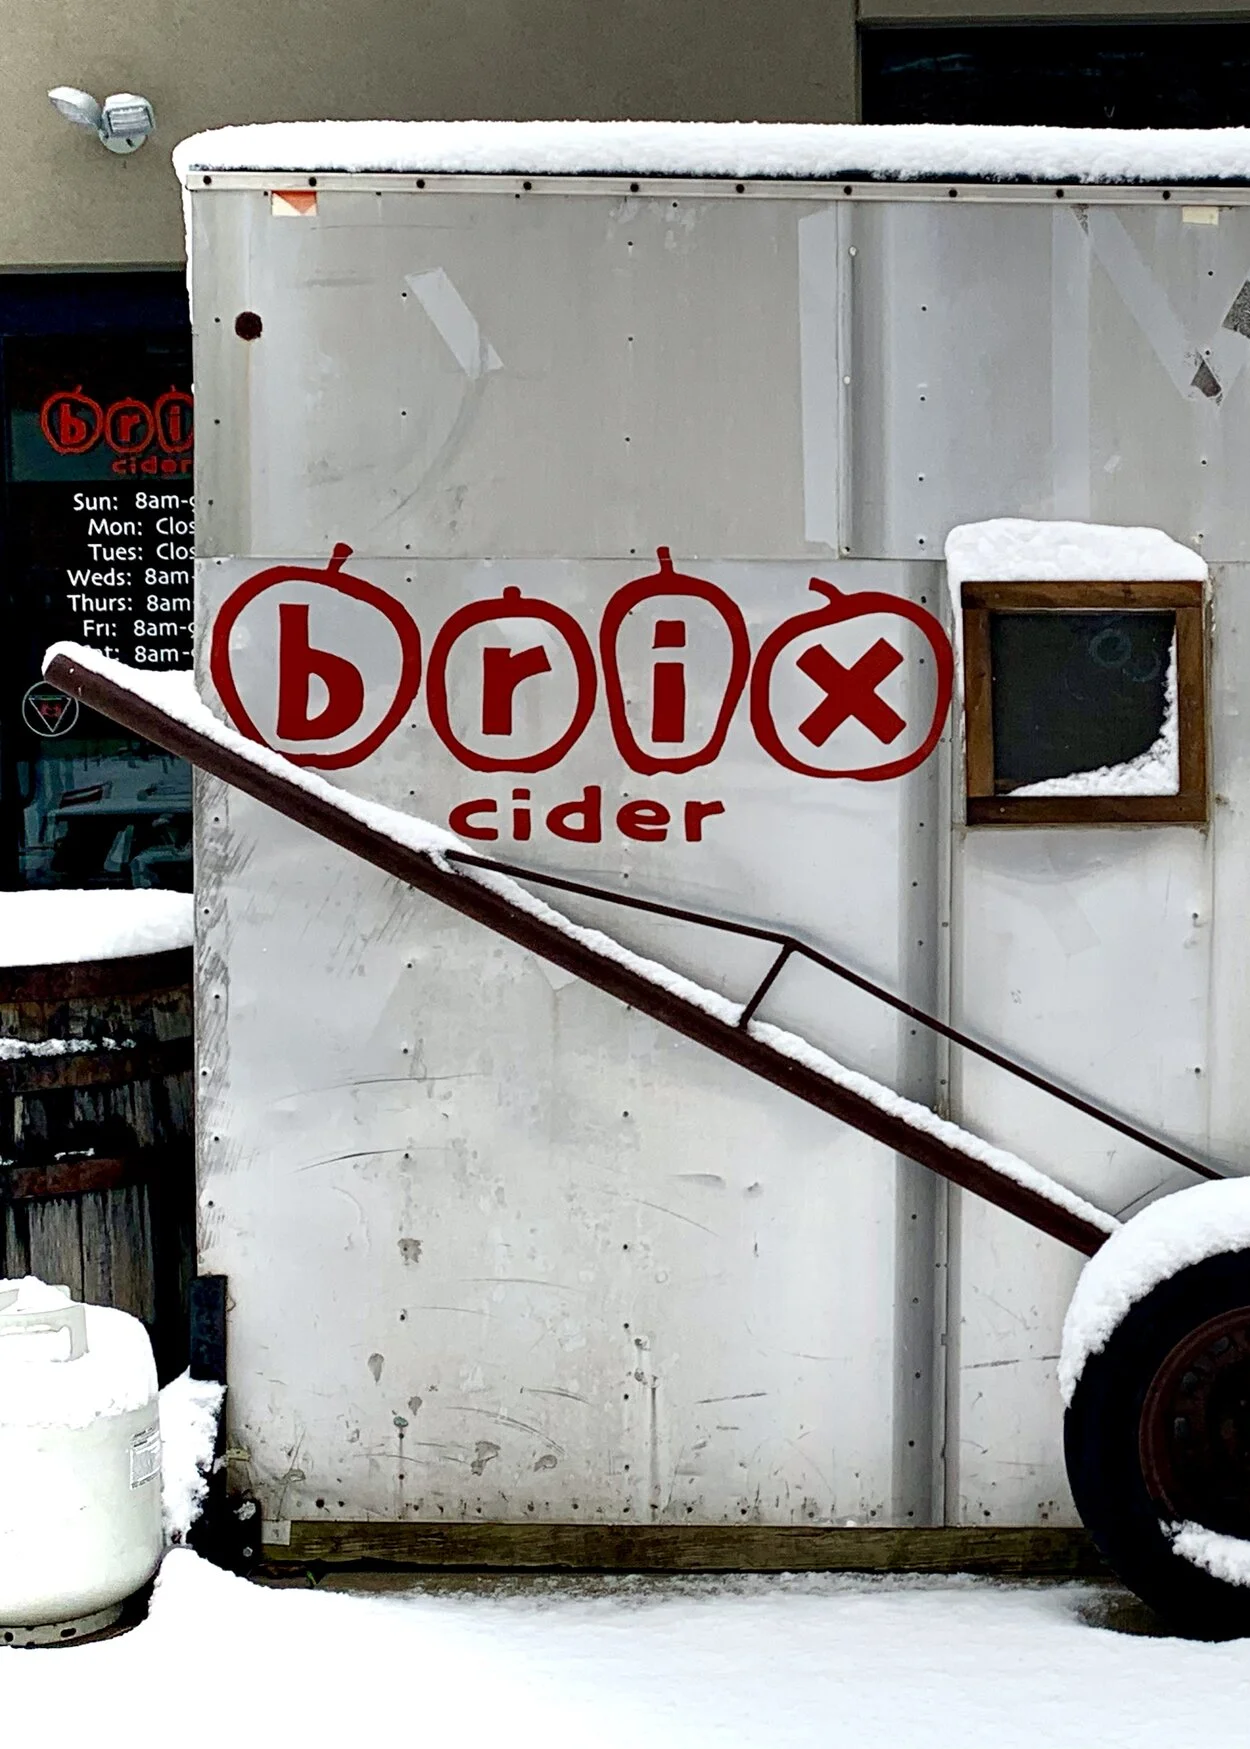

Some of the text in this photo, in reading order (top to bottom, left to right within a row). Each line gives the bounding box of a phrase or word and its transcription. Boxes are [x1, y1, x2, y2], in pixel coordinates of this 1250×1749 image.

[73, 492, 118, 511] Sun:
[87, 518, 142, 536] Mon:
[87, 543, 143, 561] Tues:
[66, 567, 132, 587] Weds:
[66, 593, 132, 612] Thurs:
[83, 619, 116, 637] Fri:
[273, 600, 910, 749] brix
[448, 785, 726, 843] cider
